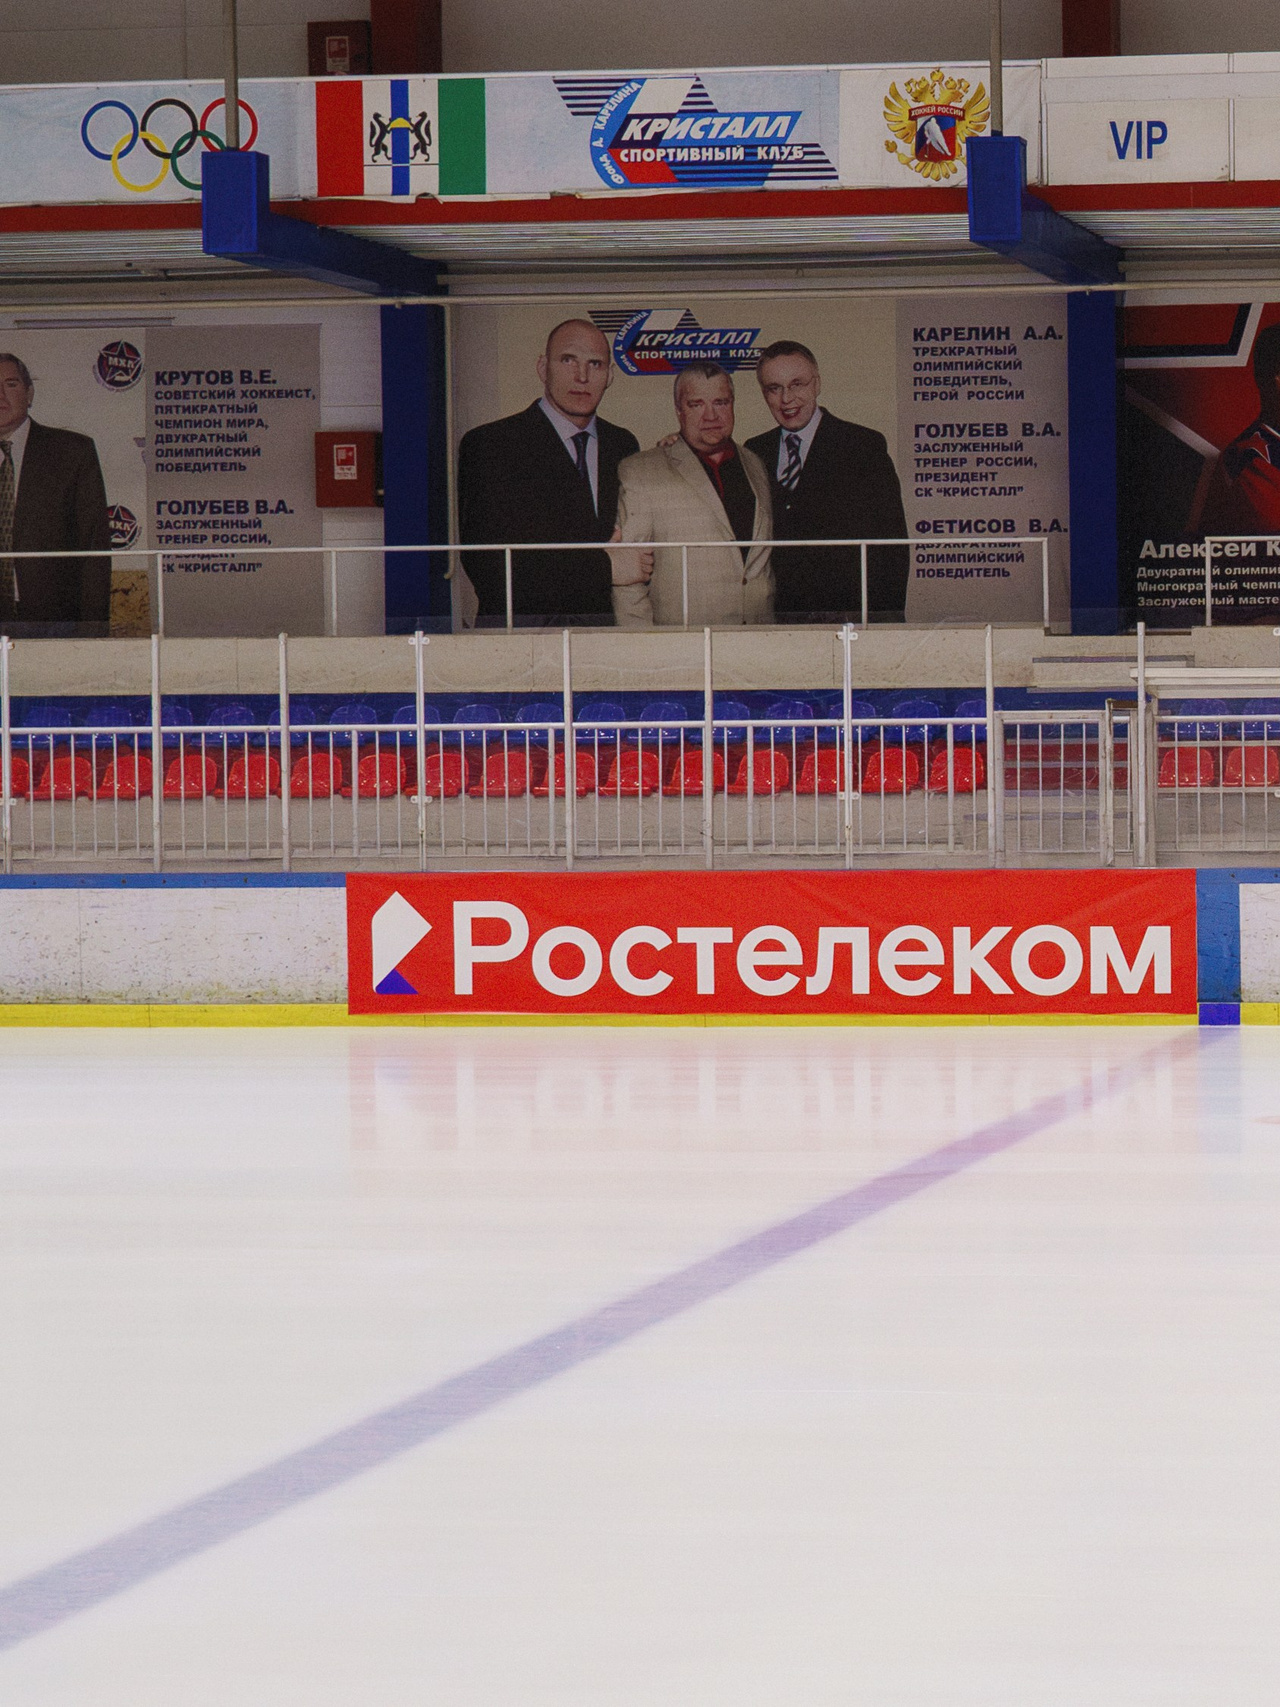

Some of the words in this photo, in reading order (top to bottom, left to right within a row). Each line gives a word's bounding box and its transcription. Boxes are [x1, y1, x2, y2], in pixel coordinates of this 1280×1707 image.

[594, 81, 642, 130] КАРЕЛИНА
[911, 105, 936, 117] ХОККЕЙ
[937, 106, 964, 117] РОССИИ
[621, 115, 792, 141] КРИСТАЛЛ
[1109, 120, 1168, 160] VIP
[619, 145, 745, 163] СПОРТИВНЫЙ
[757, 145, 804, 161] КЛУБ
[636, 331, 753, 347] КРИСТАЛЛ
[913, 326, 1010, 342] КАРЕЛИН
[1023, 326, 1063, 341] А.А.
[634, 349, 721, 360] СПОРТИВНЫЙ
[729, 349, 761, 359] КЛУБ
[913, 344, 1017, 356] ТРЕХКРАТНЫЙ
[913, 358, 1023, 372] ОЛИМПИЙСКИЙ
[155, 370, 234, 386] КРУТОВ
[240, 369, 277, 385] В.Е.
[913, 375, 1012, 387] ПОБЕДИТЕЛЬ,
[155, 388, 236, 400] СОВЕТСКИЙ
[240, 388, 316, 400] ХОККЕИСТ,
[913, 390, 958, 401] ГЕРОЙ
[967, 390, 1024, 400] РОССИИ
[155, 402, 258, 415] ПЯТИКРАТНЫЙ
[155, 419, 222, 429] ЧЕМПИОН
[226, 418, 269, 430] МИРА,
[914, 423, 1008, 438] ГОЛУБЕВ
[1022, 422, 1061, 437] В.А.
[155, 431, 248, 445] ДВУКРАТНЫЙ
[155, 445, 261, 458] ОЛИМПИЙСКИЙ
[914, 440, 1023, 453] ЗАСЛУЖЕННЫЙ
[155, 461, 247, 473] ПОБЕДИТЕЛЬ
[914, 457, 967, 468] ТРЕНЕР
[976, 456, 1037, 468] РОССИИ,
[915, 472, 998, 483] ПРЕЗИДЕНТ
[915, 487, 932, 497] СК
[156, 500, 249, 515] ГОЛУБЕВ
[255, 500, 294, 515] В.А.
[156, 517, 262, 530] ЗАСЛУЖЕННЫЙ
[915, 519, 1016, 535] ФЕТИСОВ
[1029, 519, 1068, 533] В.А.
[156, 534, 208, 544] ТРЕНЕР
[212, 533, 272, 545] РОССИИ,
[916, 550, 1024, 563] ОЛИМПИЙСКИЙ
[916, 568, 1010, 579] ПОБЕДИТЕЛЬ
[1137, 579, 1239, 592] Многокраный
[452, 900, 1173, 996] Ростелеком
